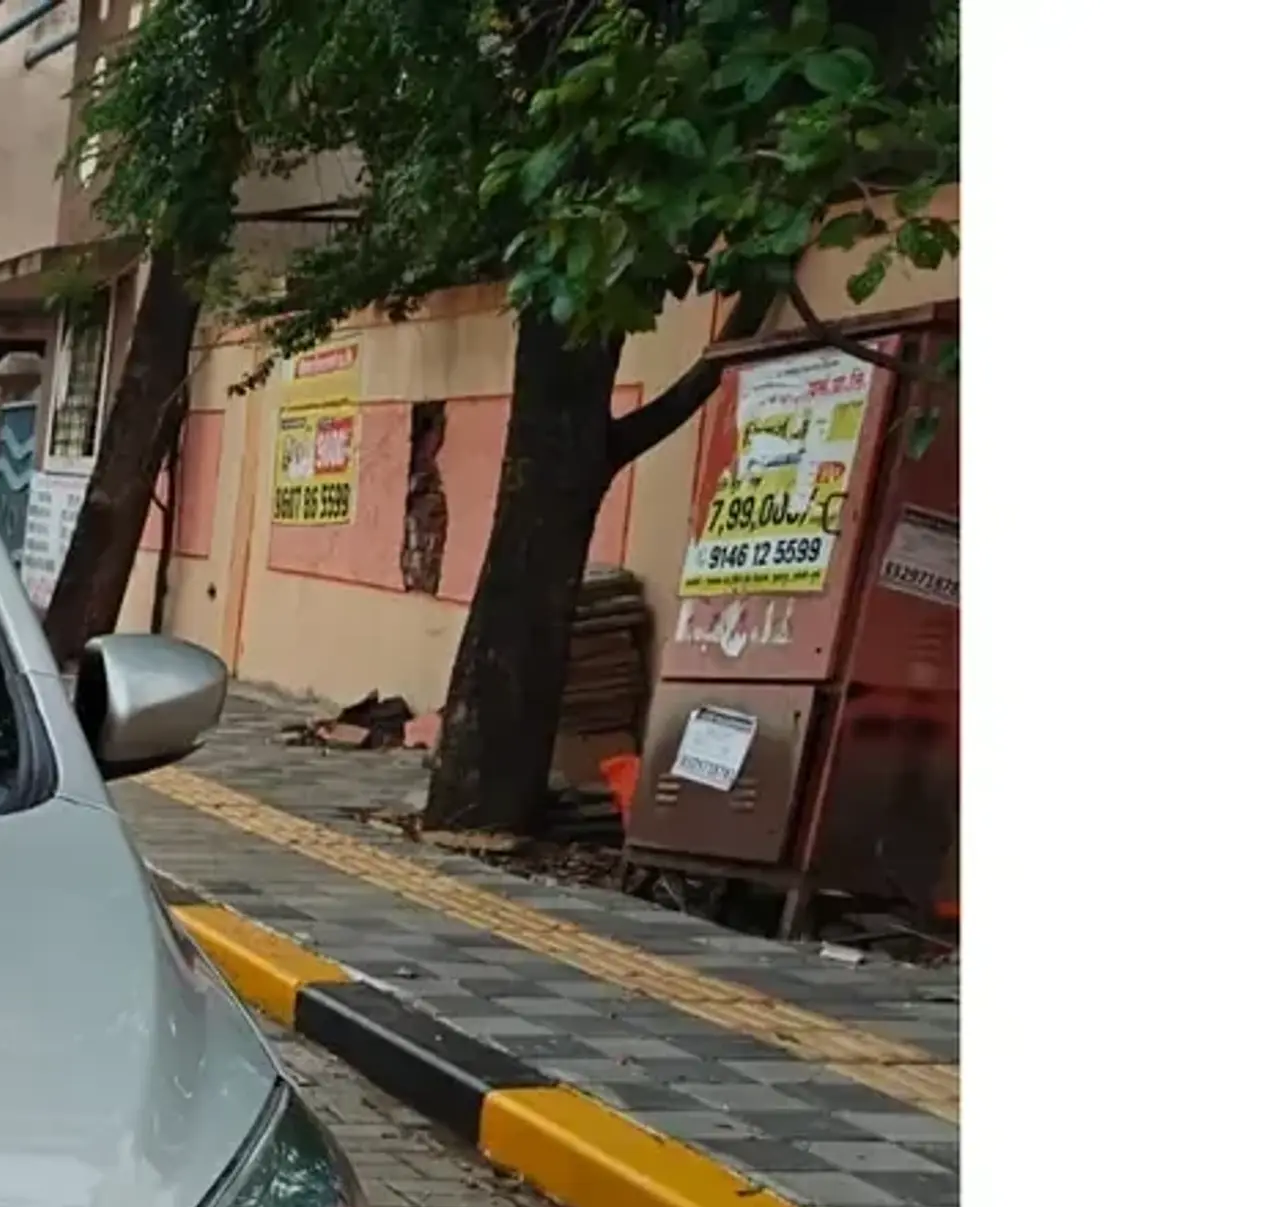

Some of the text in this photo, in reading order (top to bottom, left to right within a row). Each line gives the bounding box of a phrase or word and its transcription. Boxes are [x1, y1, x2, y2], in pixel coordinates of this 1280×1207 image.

[708, 537, 822, 569] 9146 12 5599
